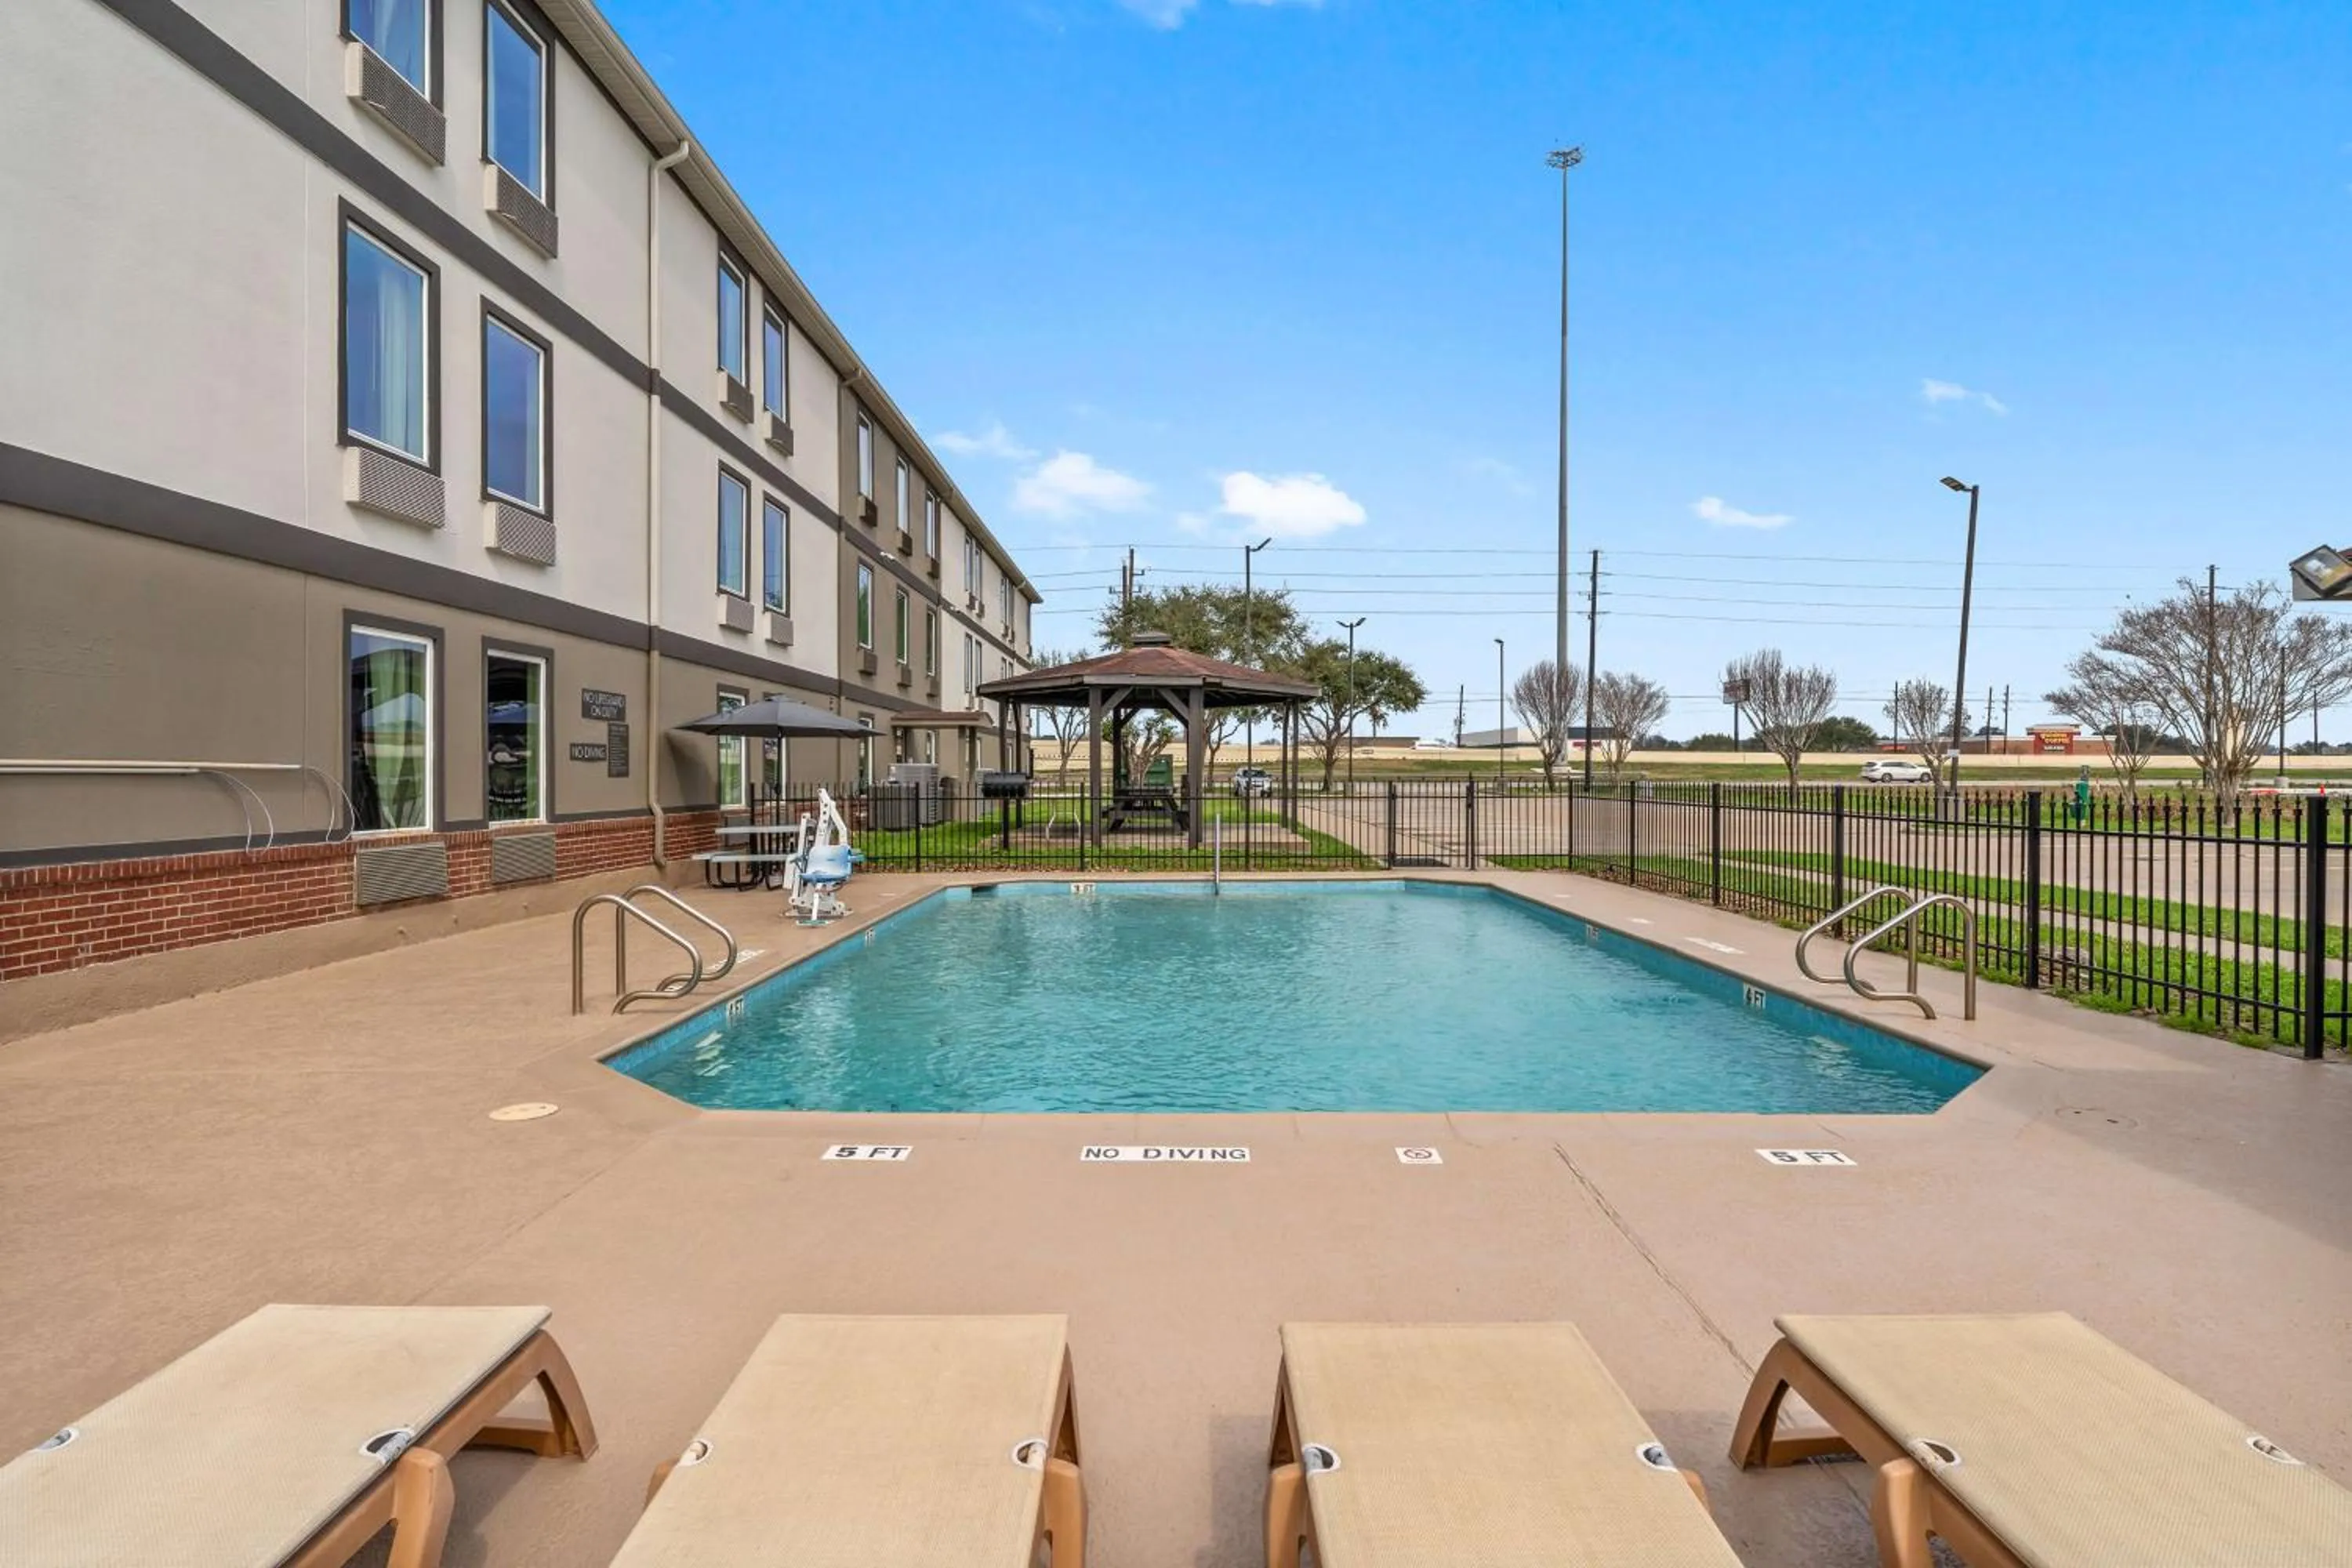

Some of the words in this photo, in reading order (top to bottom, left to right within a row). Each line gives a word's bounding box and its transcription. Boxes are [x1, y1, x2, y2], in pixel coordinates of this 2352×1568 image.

[835, 1147, 858, 1158] 5
[869, 1147, 909, 1159] FT
[1085, 1148, 1120, 1159] NO
[1143, 1149, 1247, 1160] DIVING
[1769, 1151, 1798, 1163] 5
[1804, 1151, 1845, 1163] FT
